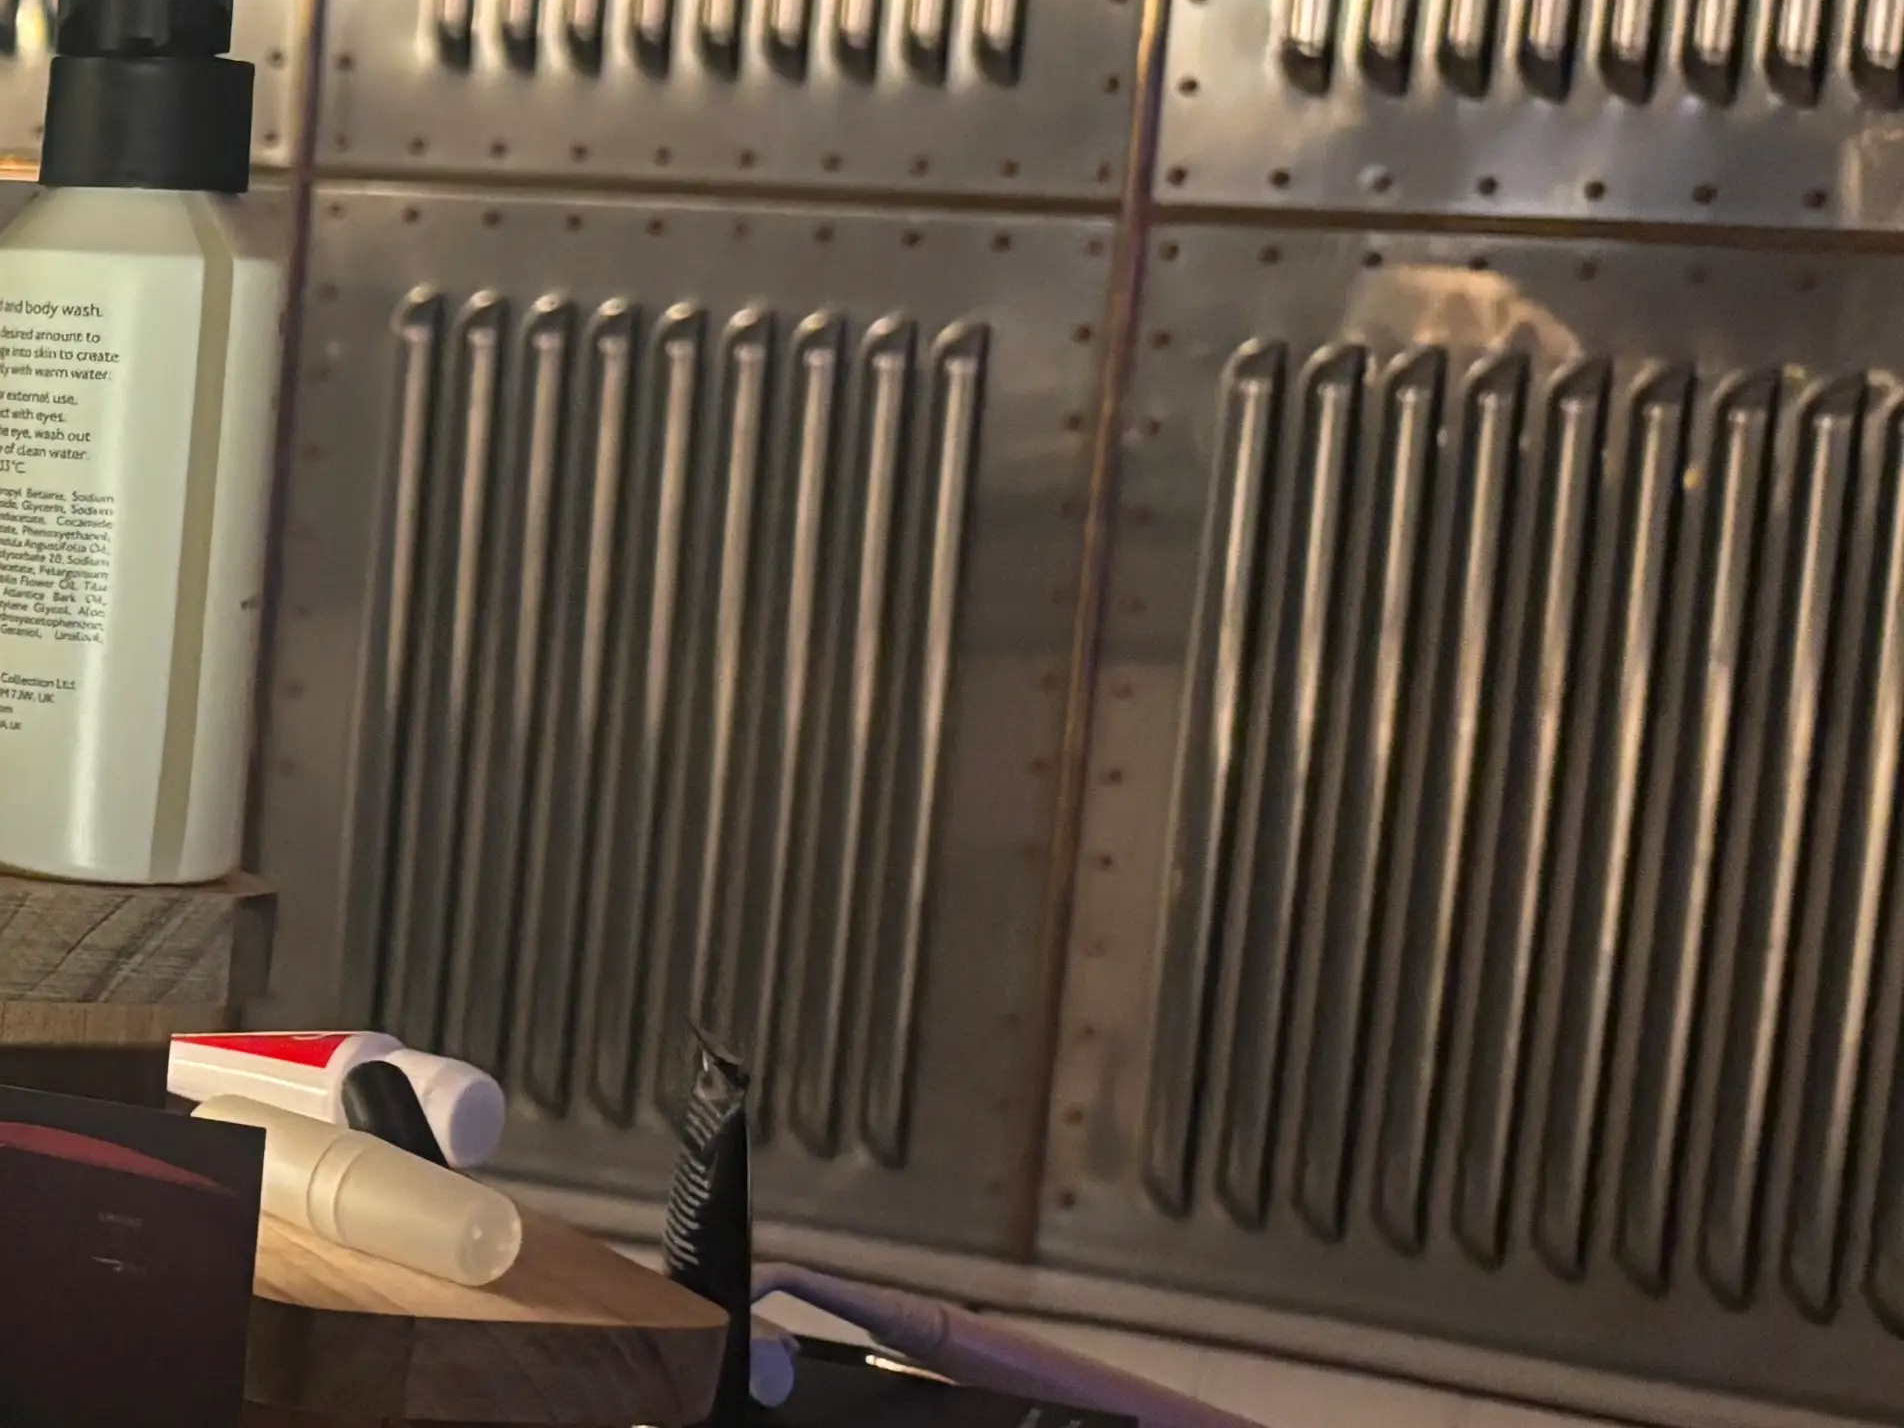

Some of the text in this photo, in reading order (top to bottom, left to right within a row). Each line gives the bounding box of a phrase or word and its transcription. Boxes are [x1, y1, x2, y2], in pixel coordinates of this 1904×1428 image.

[25, 300, 57, 319] body
[35, 332, 83, 342] amount
[86, 332, 101, 344] to
[34, 347, 57, 359] skin
[60, 350, 73, 360] to
[77, 351, 120, 363] create
[35, 368, 68, 378] warm
[7, 391, 50, 404] external
[34, 428, 65, 440] wash
[67, 431, 91, 442] out
[17, 445, 46, 457] clean
[71, 490, 114, 503] Sodium
[0, 672, 53, 687] Collection
